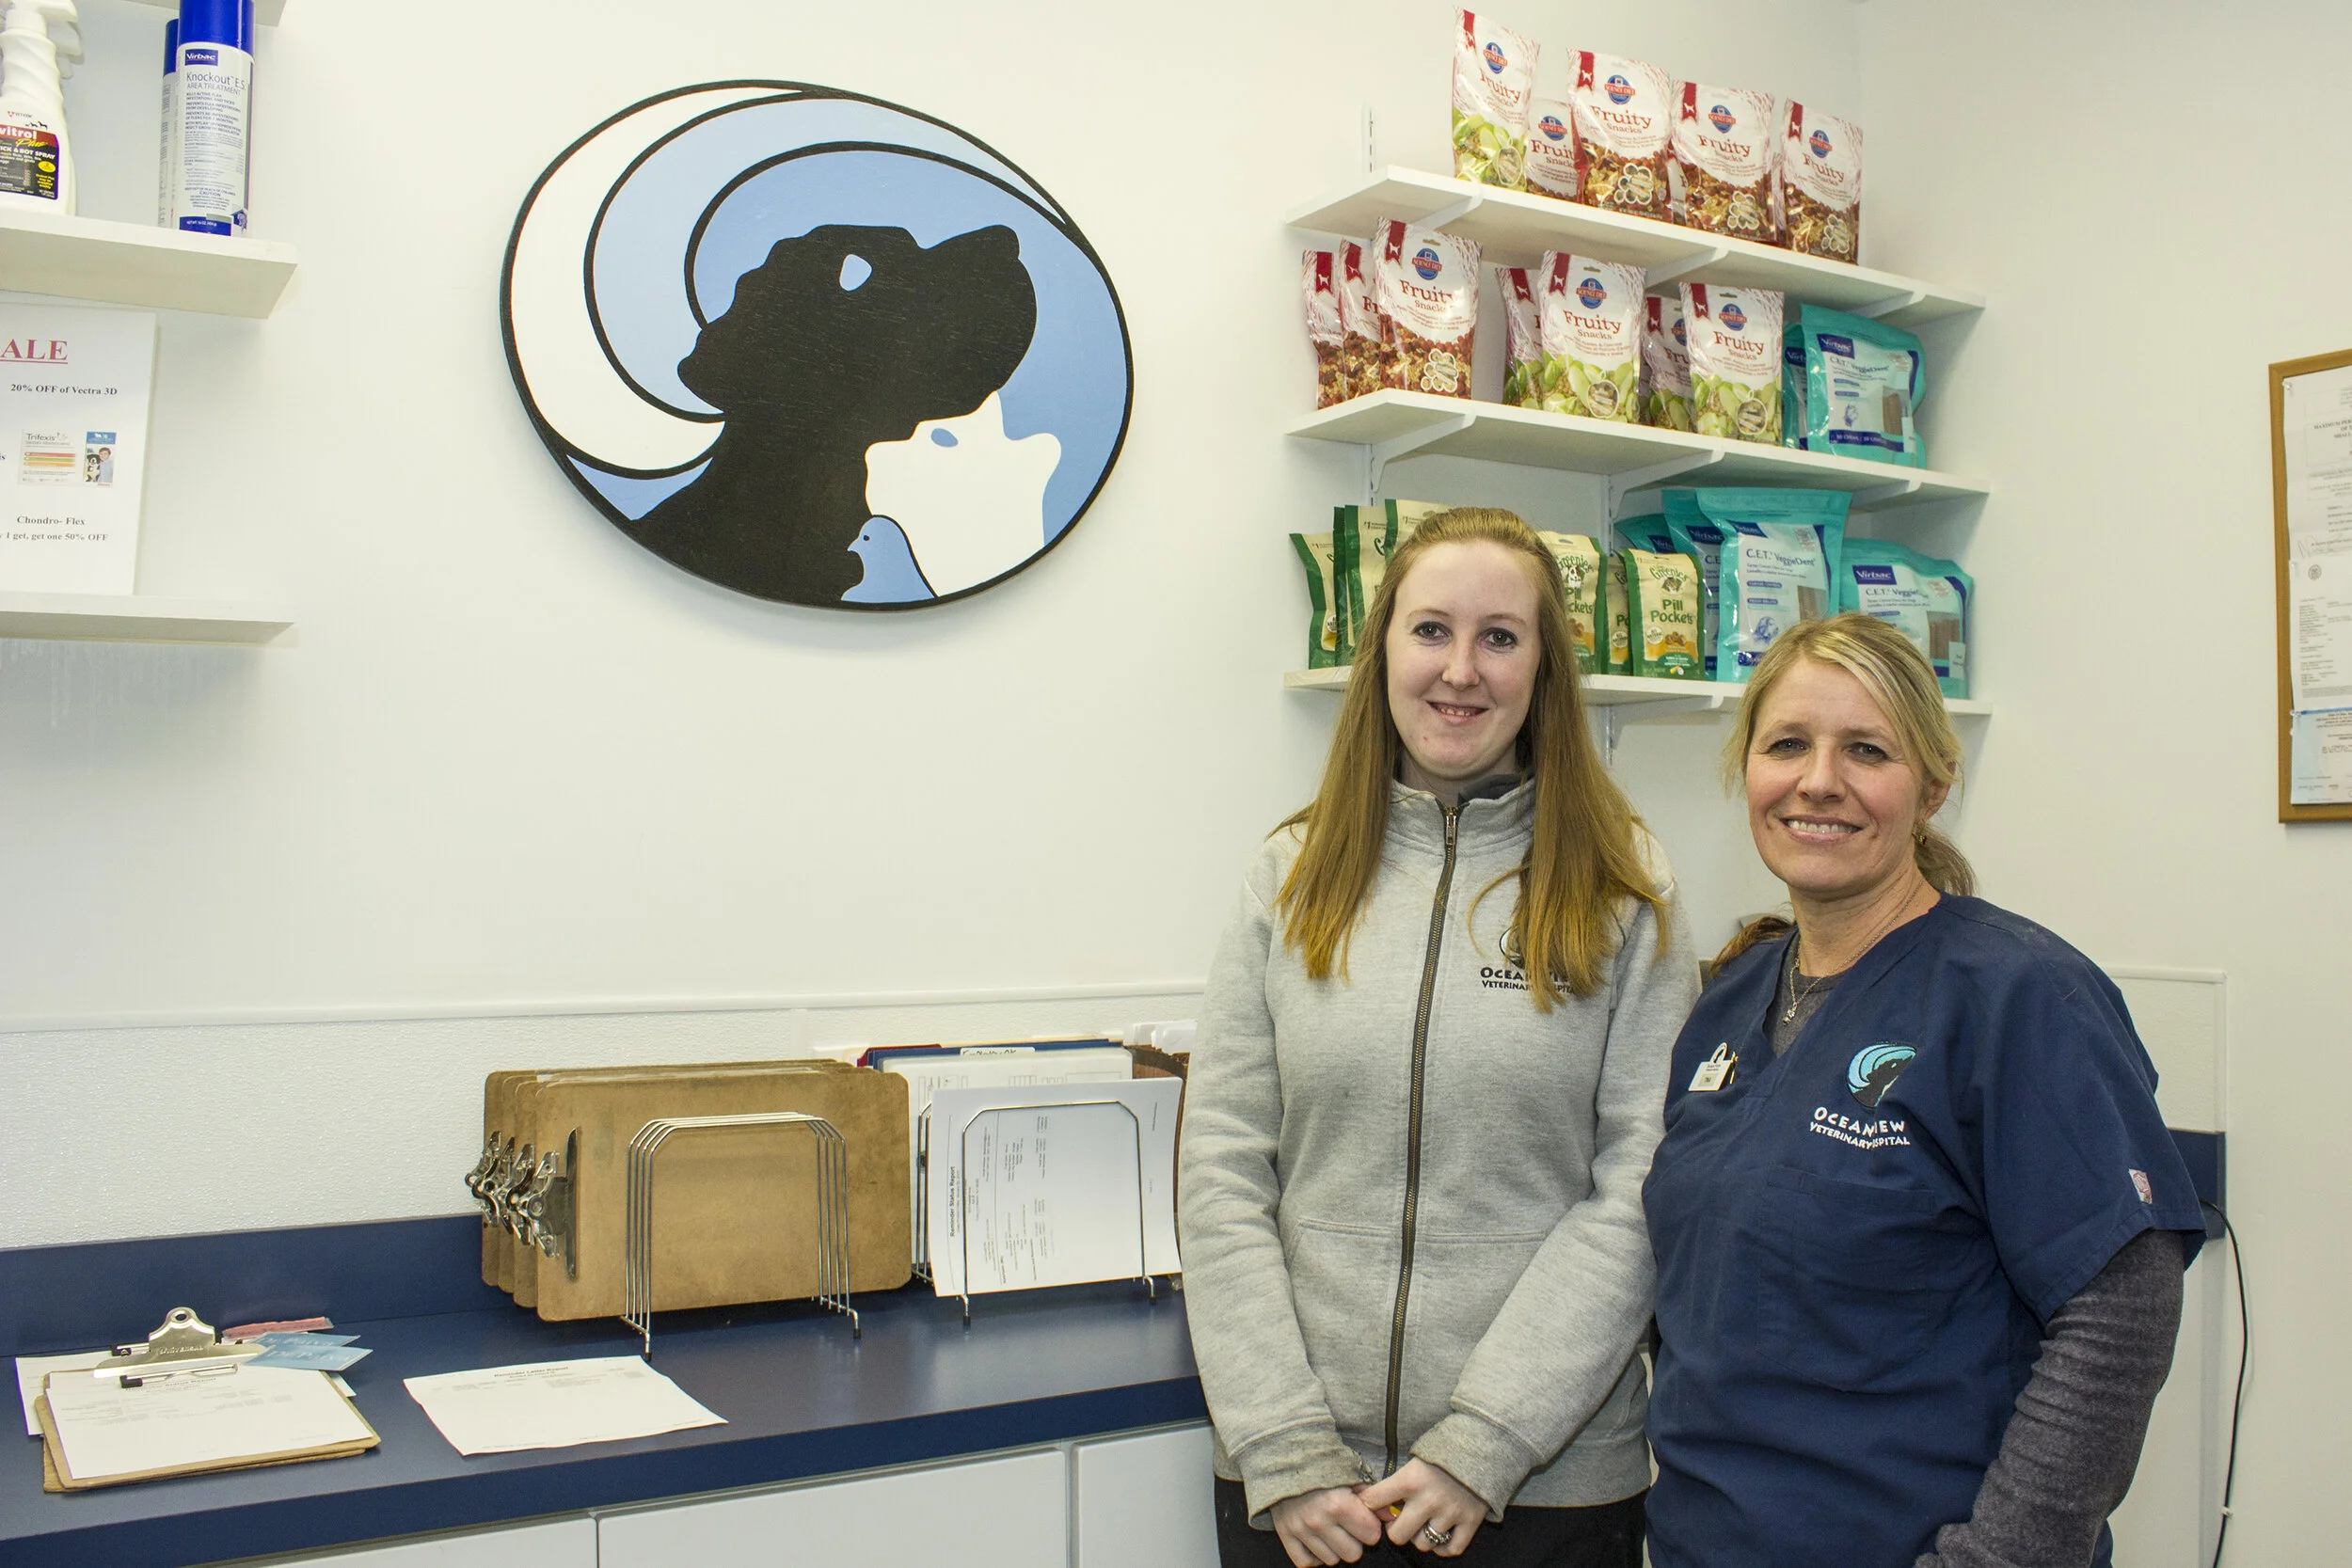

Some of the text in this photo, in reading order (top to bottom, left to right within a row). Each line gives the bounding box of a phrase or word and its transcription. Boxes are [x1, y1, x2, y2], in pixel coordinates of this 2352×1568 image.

[204, 83, 241, 95] TREATMENT
[1590, 104, 1652, 130] Fruity
[1607, 122, 1643, 134] Snacks
[1531, 139, 1575, 160] Fruit
[1697, 134, 1751, 158] Fruity
[1802, 152, 1844, 183] Fruity
[1563, 309, 1622, 335] Fruity
[1577, 328, 1613, 340] Snacks
[1713, 330, 1765, 356] Fruity
[1663, 346, 1691, 365] Fru
[1728, 349, 1756, 360] Snacks
[11, 384, 33, 392] 20%
[36, 385, 57, 393] OFF
[72, 387, 102, 395] Vectra
[26, 433, 56, 441] Trifexis
[66, 517, 86, 526] Flex
[1649, 564, 1688, 582] Greenies
[1855, 570, 1892, 579] Virbac
[1567, 601, 1593, 614] ckets
[1662, 599, 1683, 611] Pill
[1650, 610, 1693, 626] Pockets
[1809, 1121, 1873, 1149] VETERINARY
